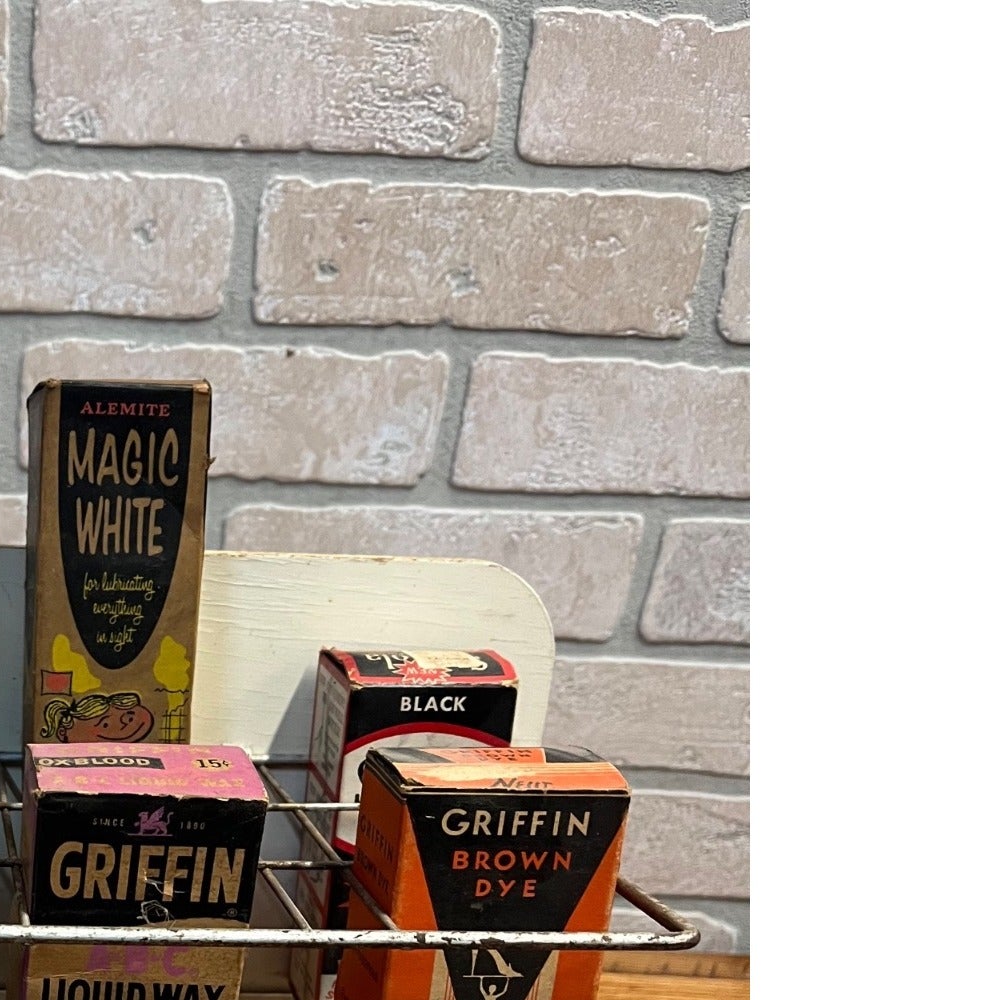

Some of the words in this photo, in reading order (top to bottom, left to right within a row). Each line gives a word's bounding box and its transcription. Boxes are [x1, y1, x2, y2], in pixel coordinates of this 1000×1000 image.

[80, 401, 171, 417] ALEMITE
[67, 428, 179, 487] MAGIC
[76, 496, 165, 556] WHITE
[83, 572, 99, 600] for
[101, 571, 155, 601] lubricating
[93, 597, 144, 625] everything
[96, 631, 107, 643] in
[109, 624, 137, 652] sight
[400, 696, 467, 712] BLACK
[38, 757, 151, 767] OXBLOOD
[92, 817, 125, 828] SINCE
[441, 808, 591, 837] GRIFFIN
[50, 841, 246, 903] GRIFFIN
[452, 851, 571, 871] BROWN
[475, 879, 536, 897] DYE
